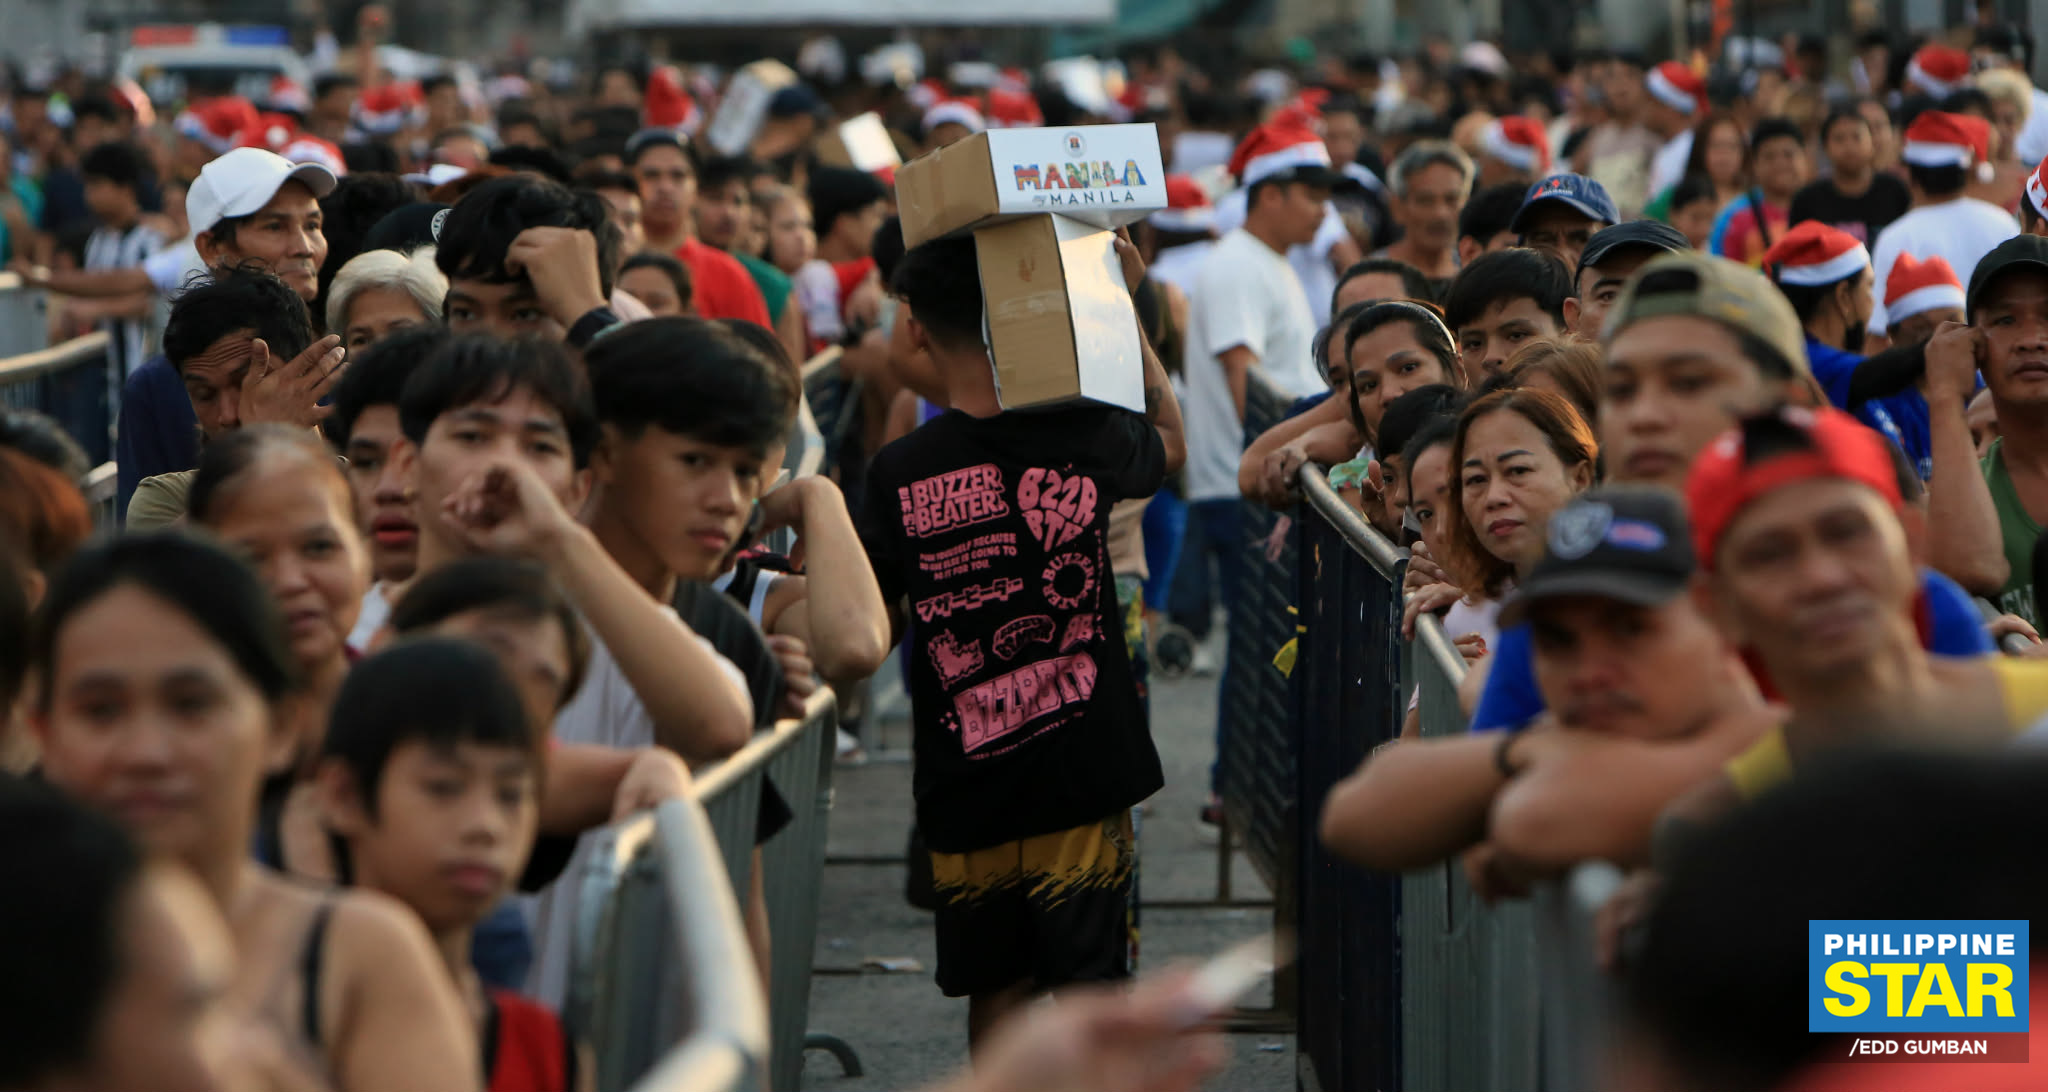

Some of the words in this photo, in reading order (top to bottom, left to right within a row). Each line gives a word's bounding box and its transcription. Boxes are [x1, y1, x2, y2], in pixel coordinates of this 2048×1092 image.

[1013, 159, 1148, 190] MANILA
[1050, 190, 1136, 206] MANILA
[911, 464, 1002, 508] BUZZER
[1002, 545, 1018, 556] TO
